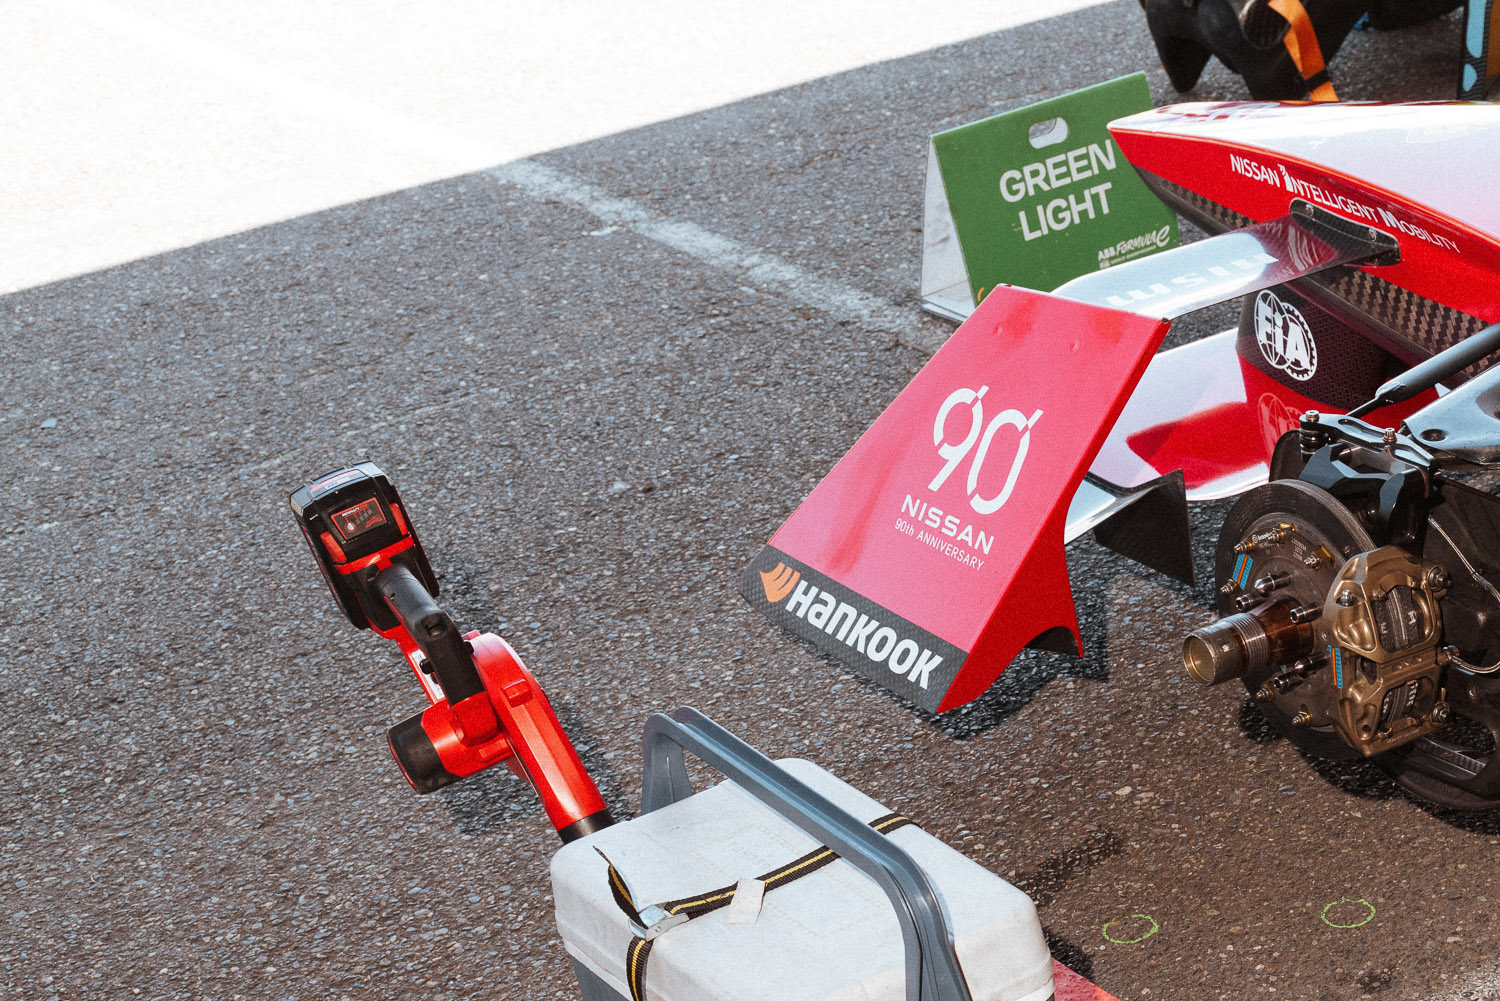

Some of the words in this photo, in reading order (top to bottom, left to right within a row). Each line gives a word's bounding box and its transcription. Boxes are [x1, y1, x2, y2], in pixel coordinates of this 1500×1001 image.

[999, 139, 1117, 203] GREEN
[1230, 153, 1281, 188] NISSAN
[1278, 163, 1379, 223] INTELLIGENT
[1377, 207, 1460, 253] MOBILITY
[1018, 181, 1113, 242] LIGHT
[1257, 299, 1312, 371] FIA
[927, 384, 1044, 515] 90
[894, 518, 915, 537] 90th
[916, 529, 985, 571] ANNIVERSARY
[901, 494, 995, 555] NISSAN
